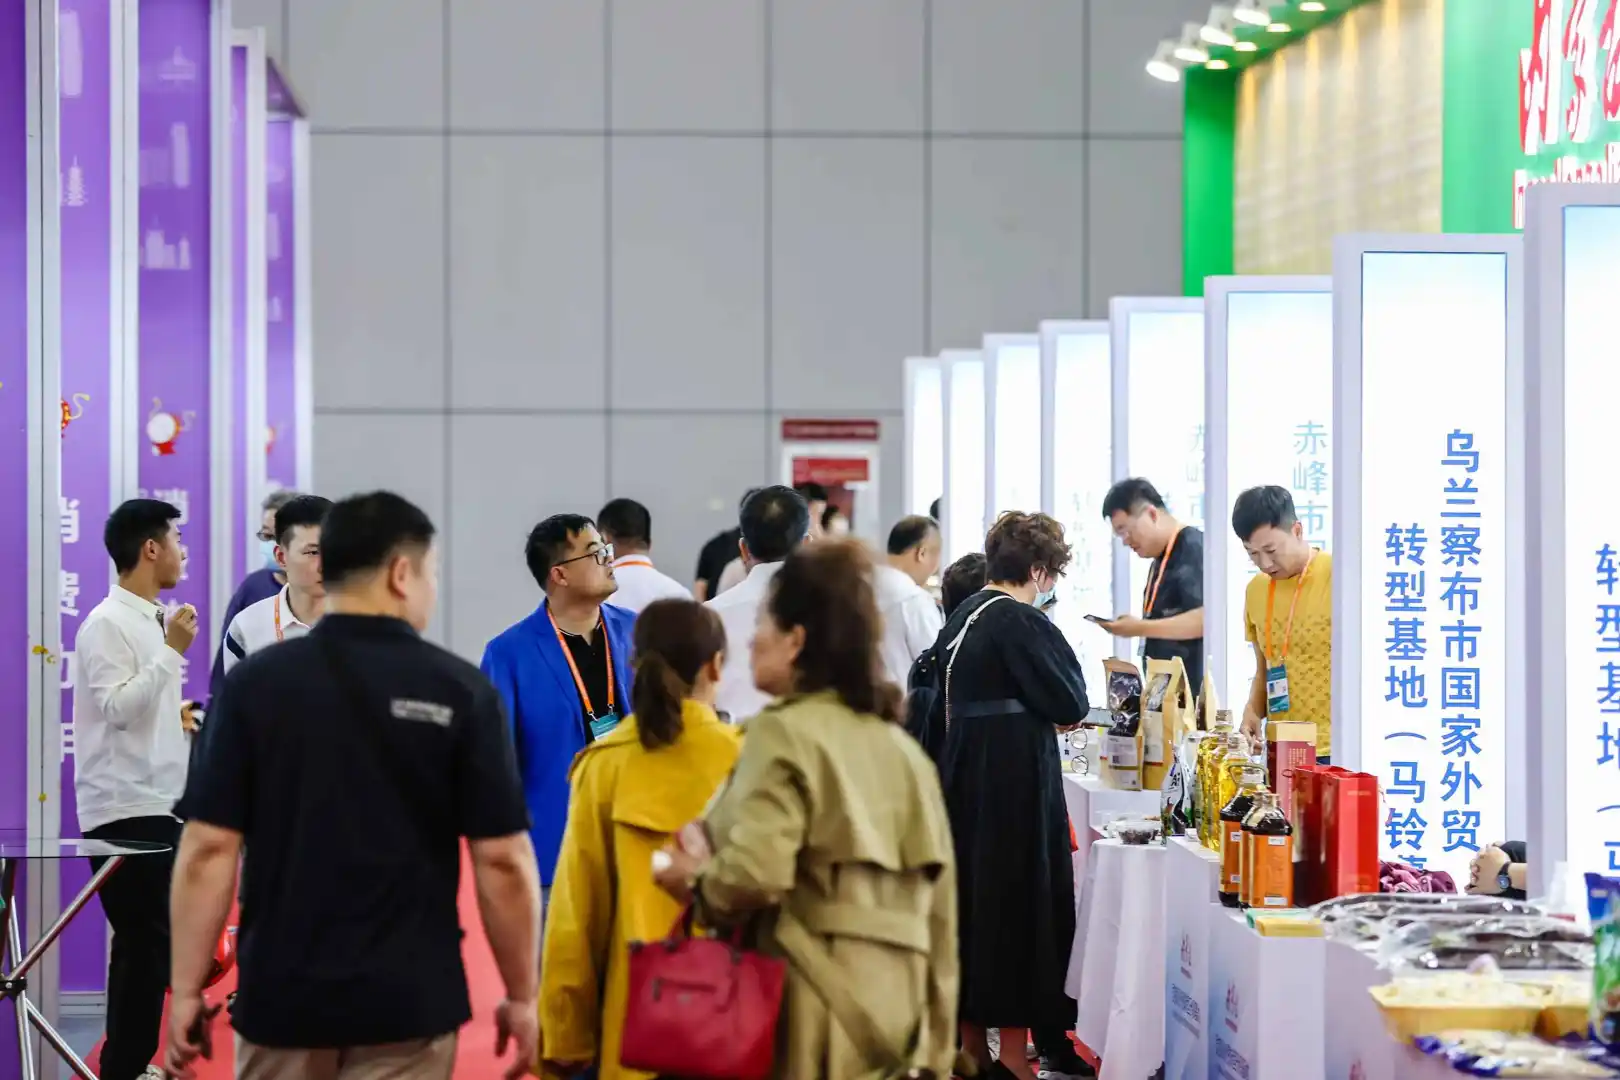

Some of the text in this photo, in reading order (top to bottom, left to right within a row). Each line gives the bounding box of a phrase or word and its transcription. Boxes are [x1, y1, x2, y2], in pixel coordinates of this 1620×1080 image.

[1440, 429, 1482, 852] 乌兰察布市国家外贸
